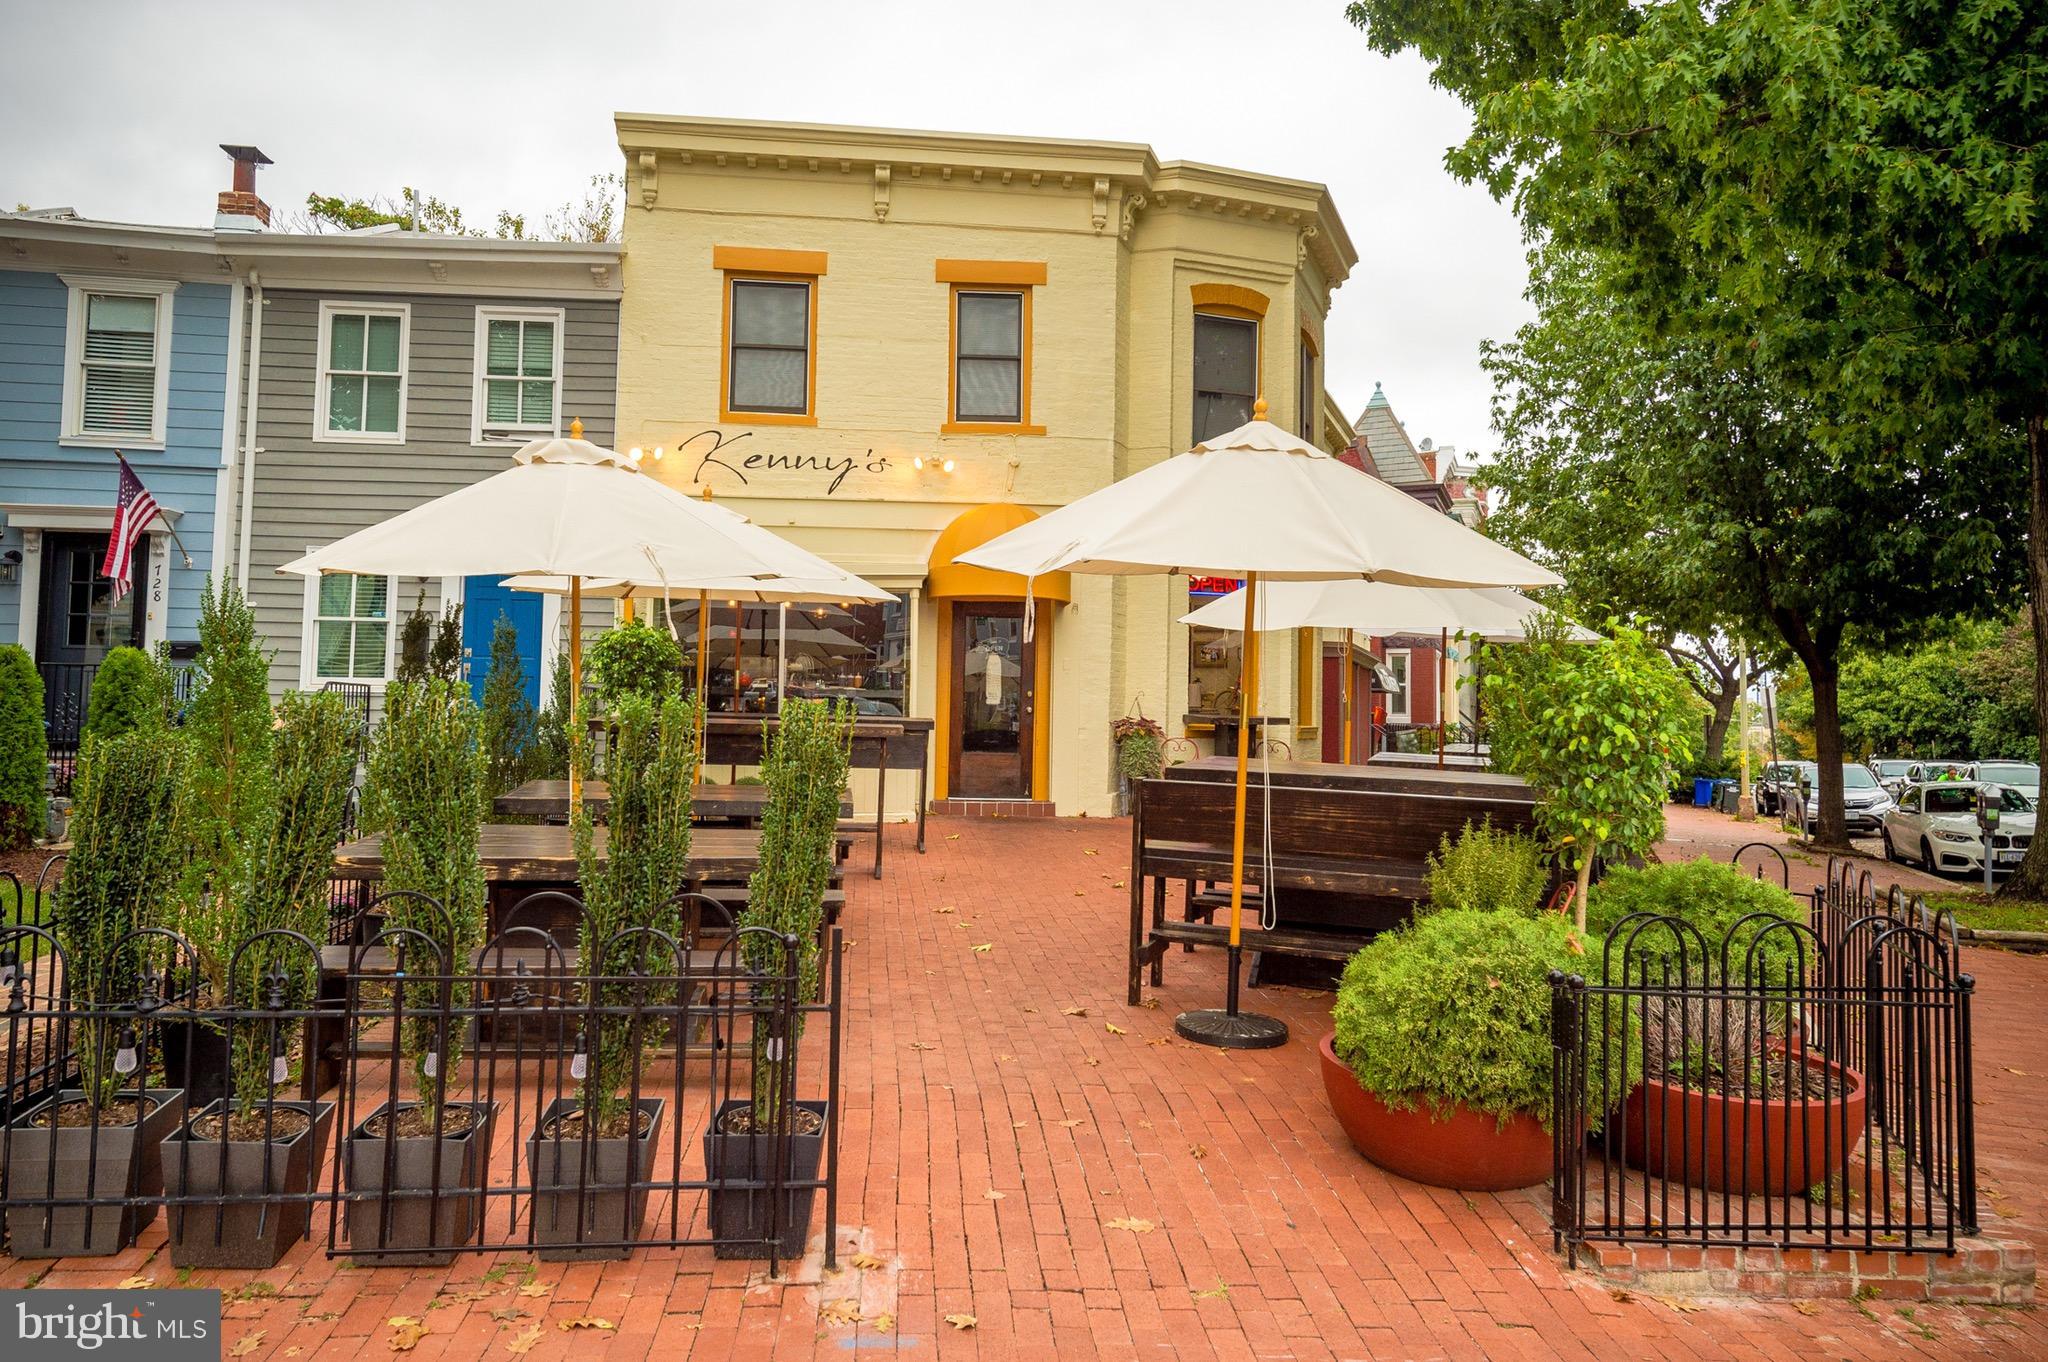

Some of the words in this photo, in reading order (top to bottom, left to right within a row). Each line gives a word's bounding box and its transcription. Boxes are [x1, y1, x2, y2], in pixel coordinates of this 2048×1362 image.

[678, 430, 892, 495] Kenny's
[153, 564, 161, 601] 728
[1189, 576, 1237, 593] OPEN
